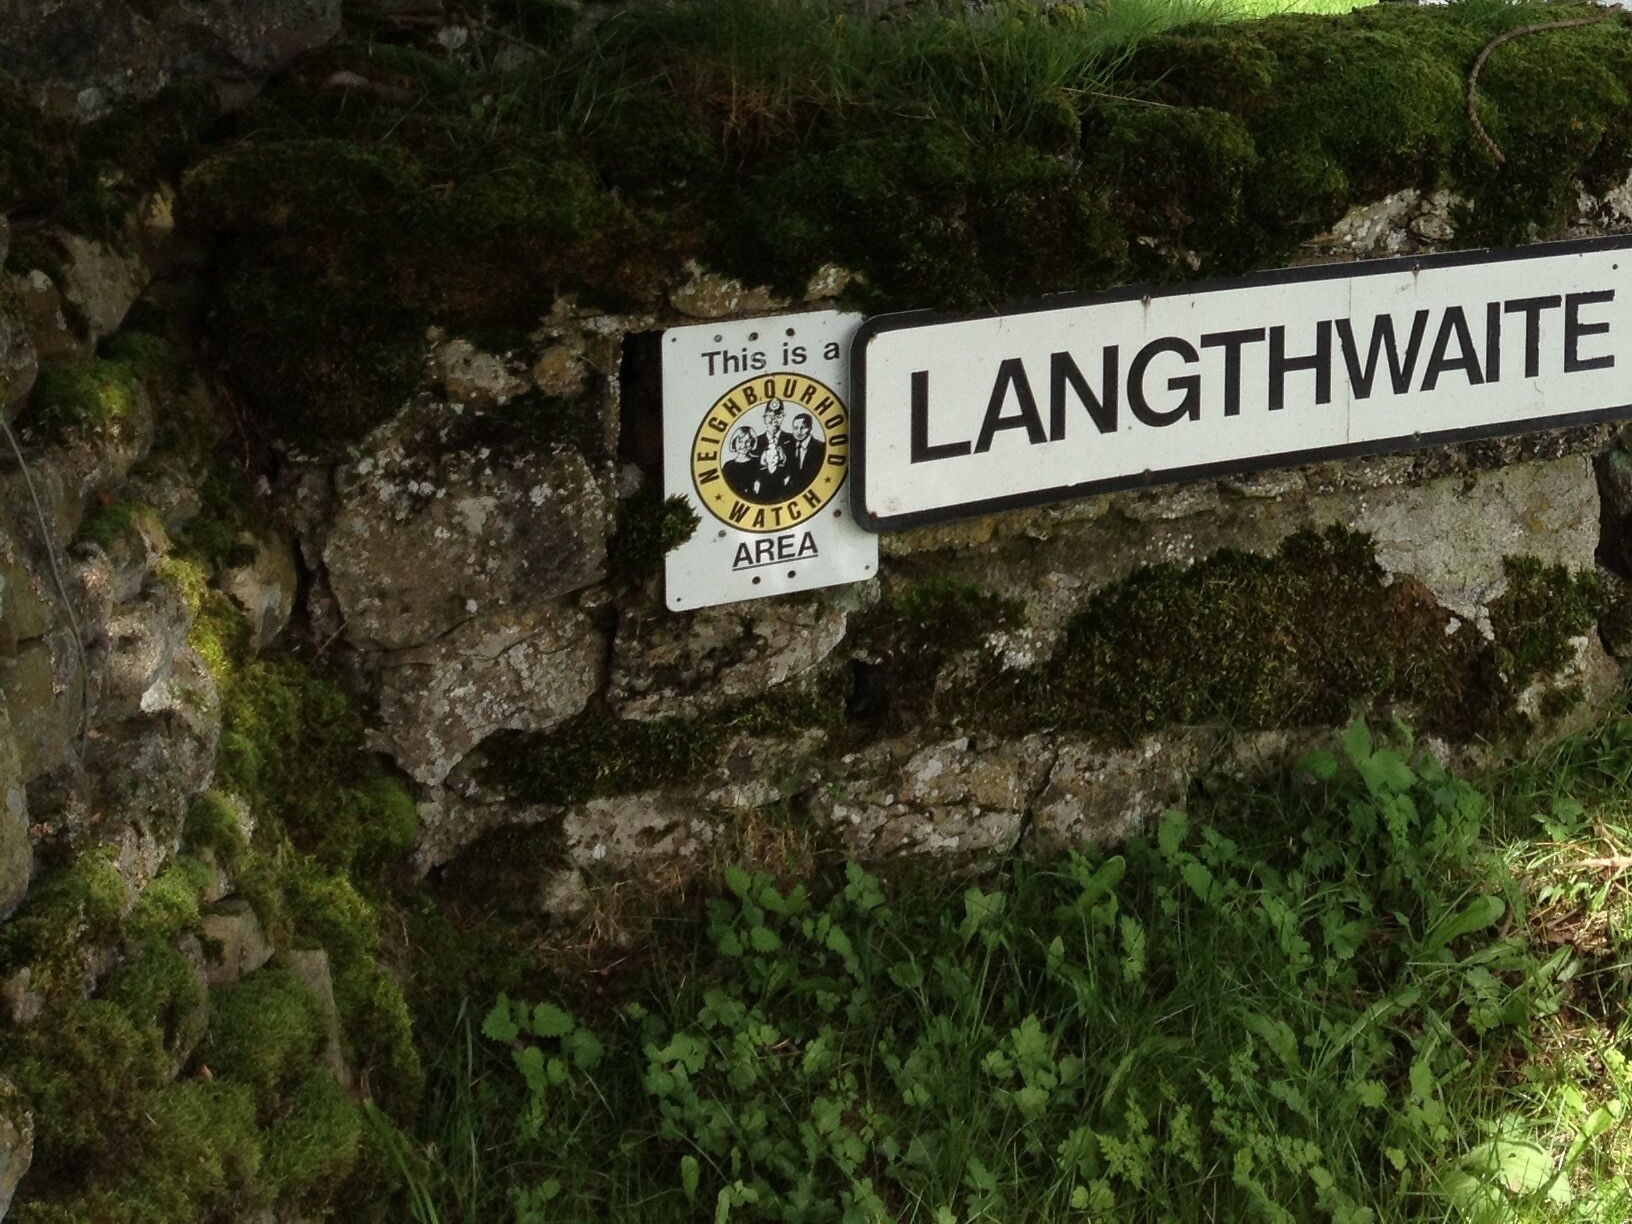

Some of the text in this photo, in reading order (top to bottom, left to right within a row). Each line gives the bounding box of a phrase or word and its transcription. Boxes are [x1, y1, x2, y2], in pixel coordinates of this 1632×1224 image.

[701, 341, 841, 376] This is a
[909, 289, 1616, 464] LANGTHWAITE
[697, 378, 849, 486] NEIGHBOURHOOD
[729, 487, 822, 528] WATCH
[731, 531, 819, 568] AREA
